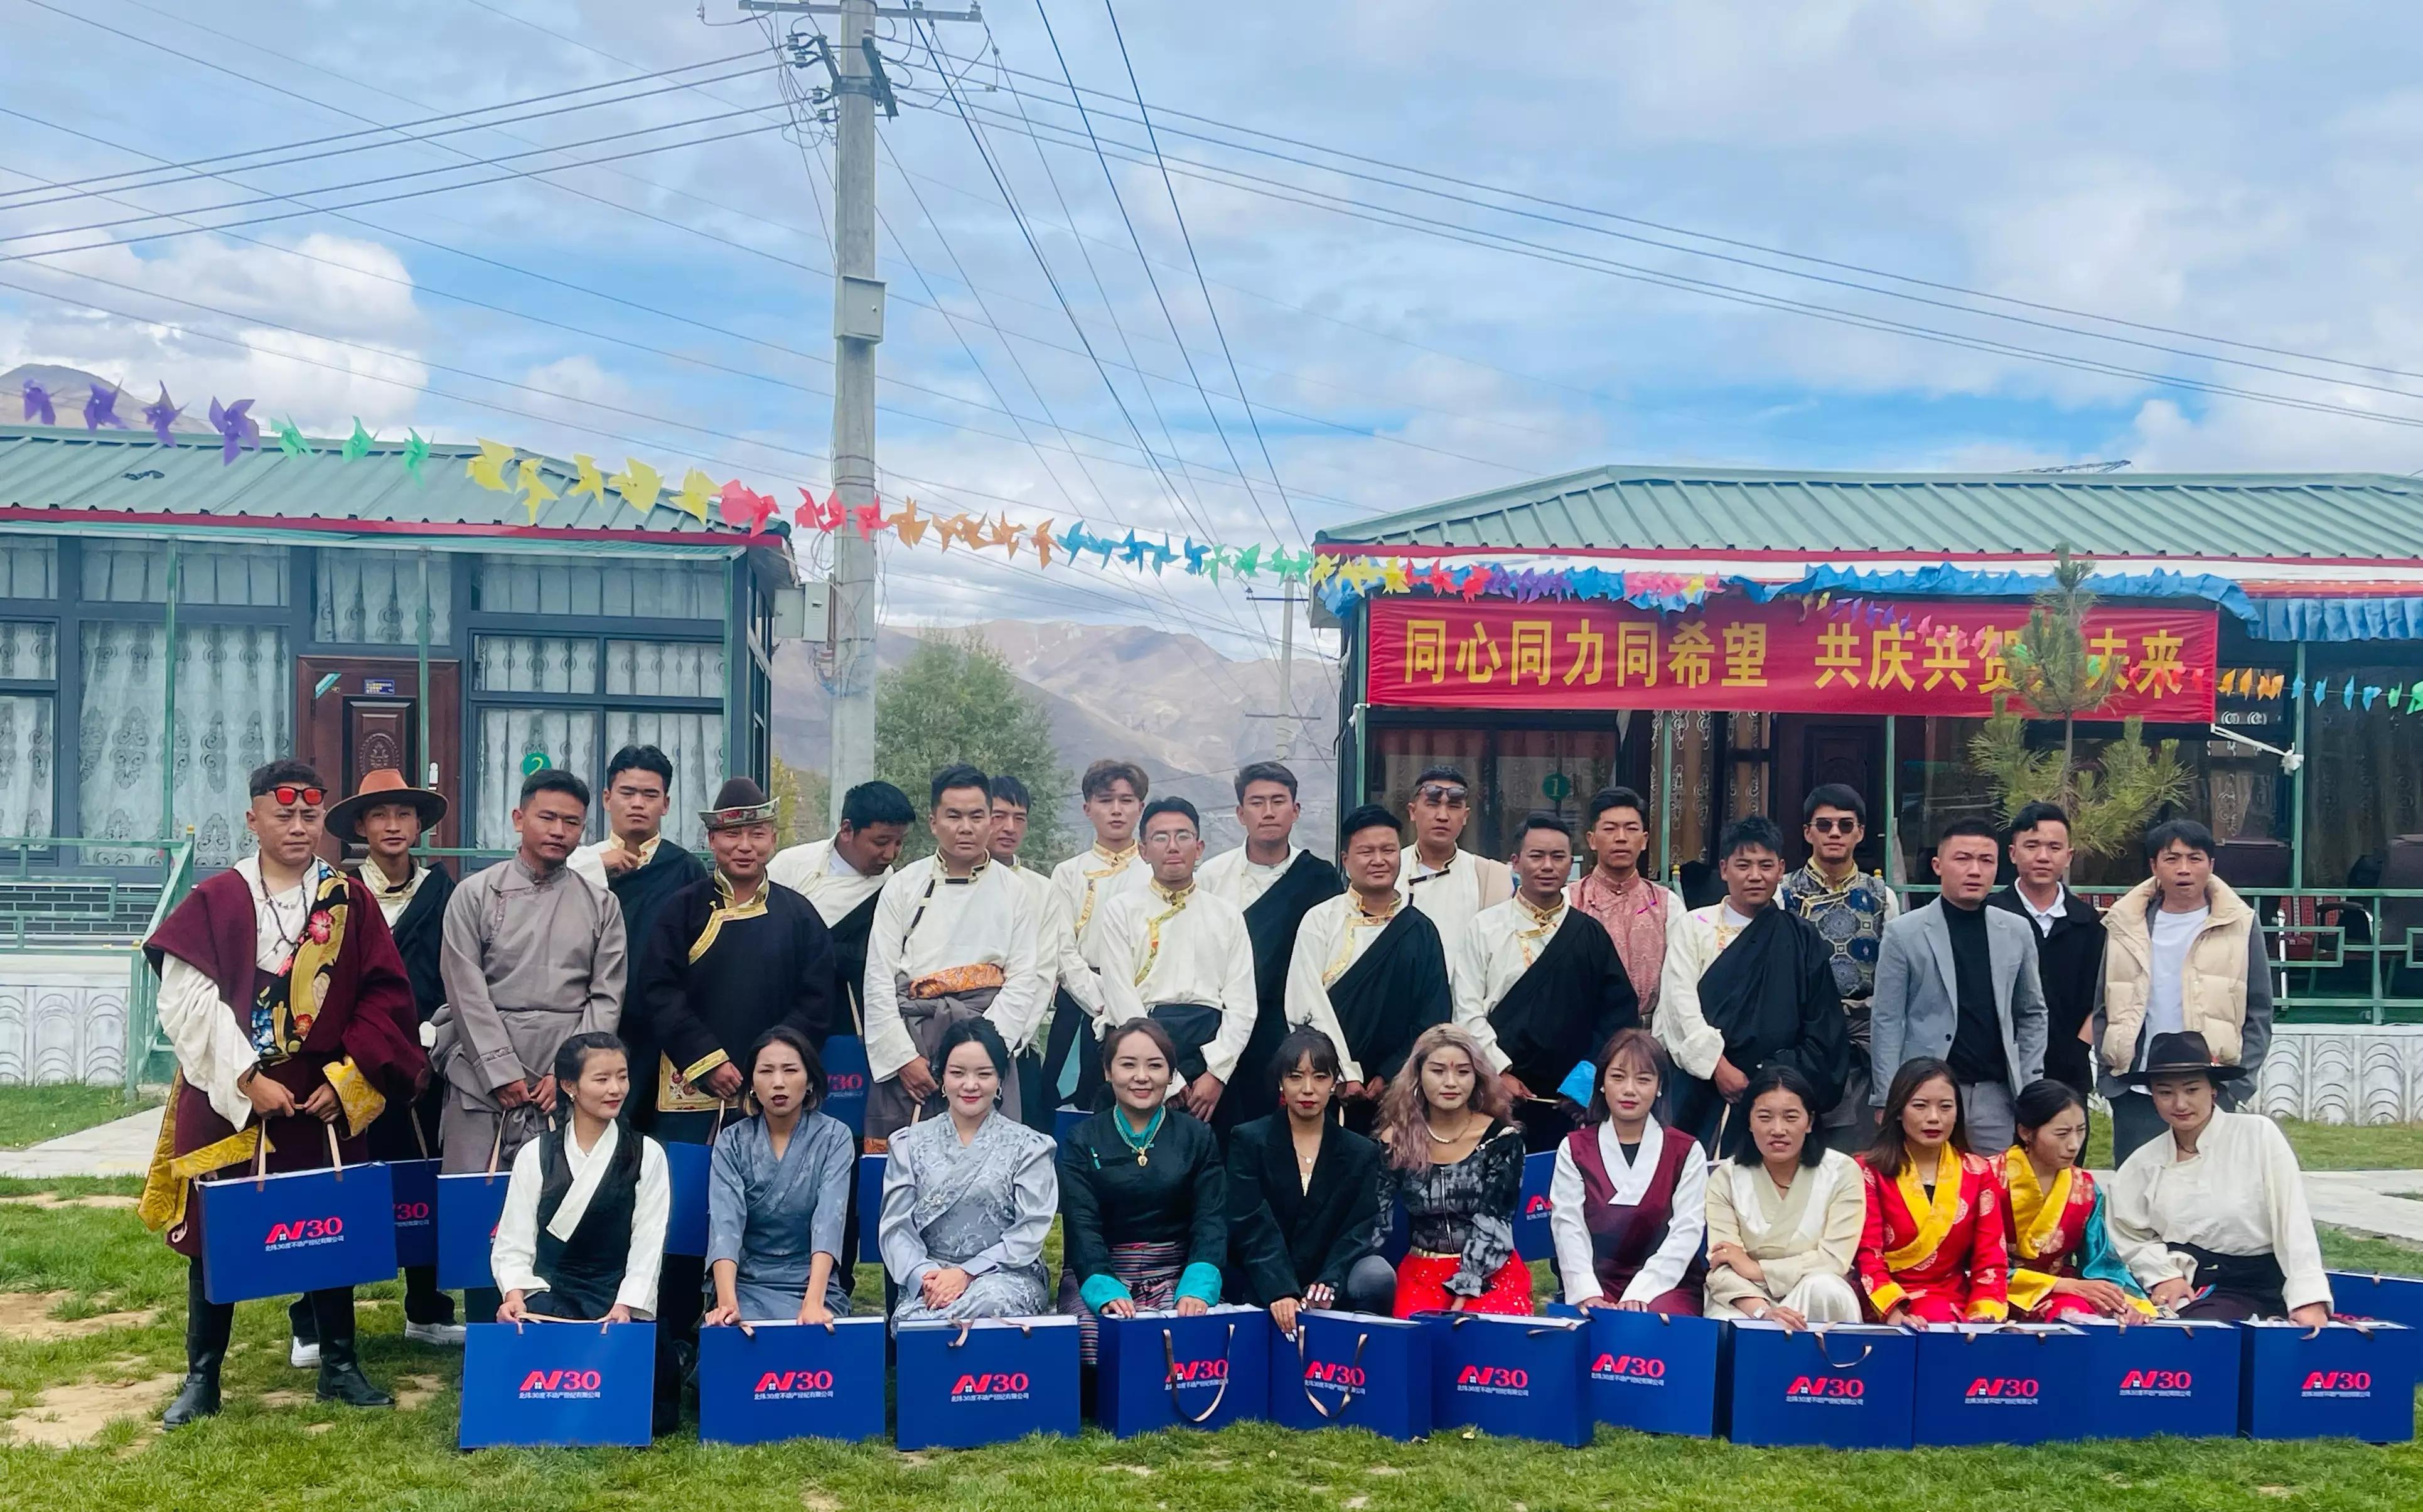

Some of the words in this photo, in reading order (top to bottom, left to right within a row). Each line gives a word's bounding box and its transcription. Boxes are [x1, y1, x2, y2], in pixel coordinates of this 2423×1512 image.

[1405, 619, 1769, 689] 同心同力同希望
[1814, 621, 2184, 699] 共庆共贺未来
[531, 756, 544, 776] 2
[1550, 778, 1561, 796] 1
